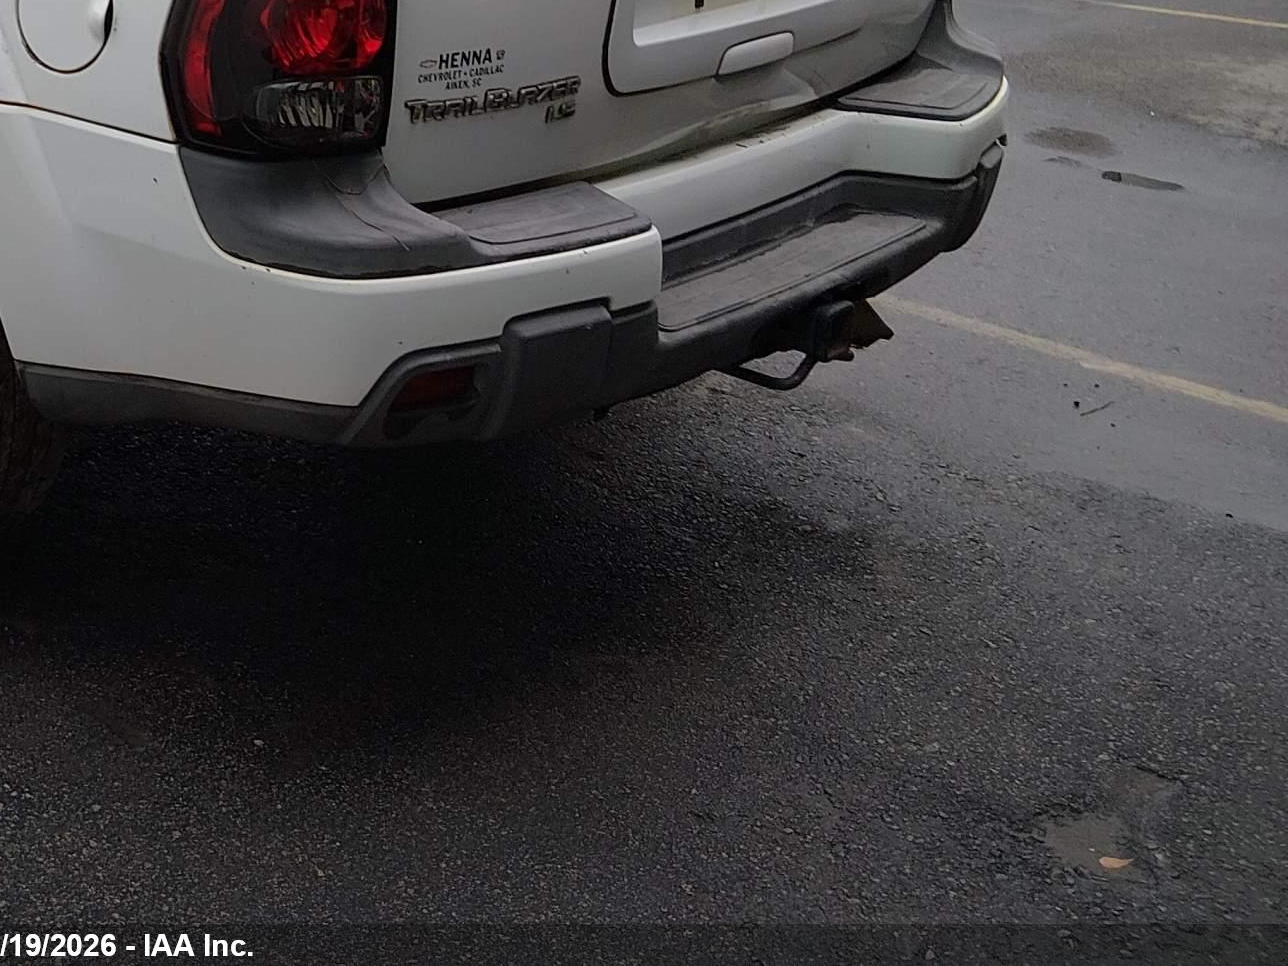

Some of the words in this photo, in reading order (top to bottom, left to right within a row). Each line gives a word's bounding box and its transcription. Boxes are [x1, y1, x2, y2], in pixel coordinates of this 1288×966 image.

[438, 48, 493, 70] HENNA
[418, 69, 462, 84] CHEVROLET
[469, 64, 505, 78] CADILLAC
